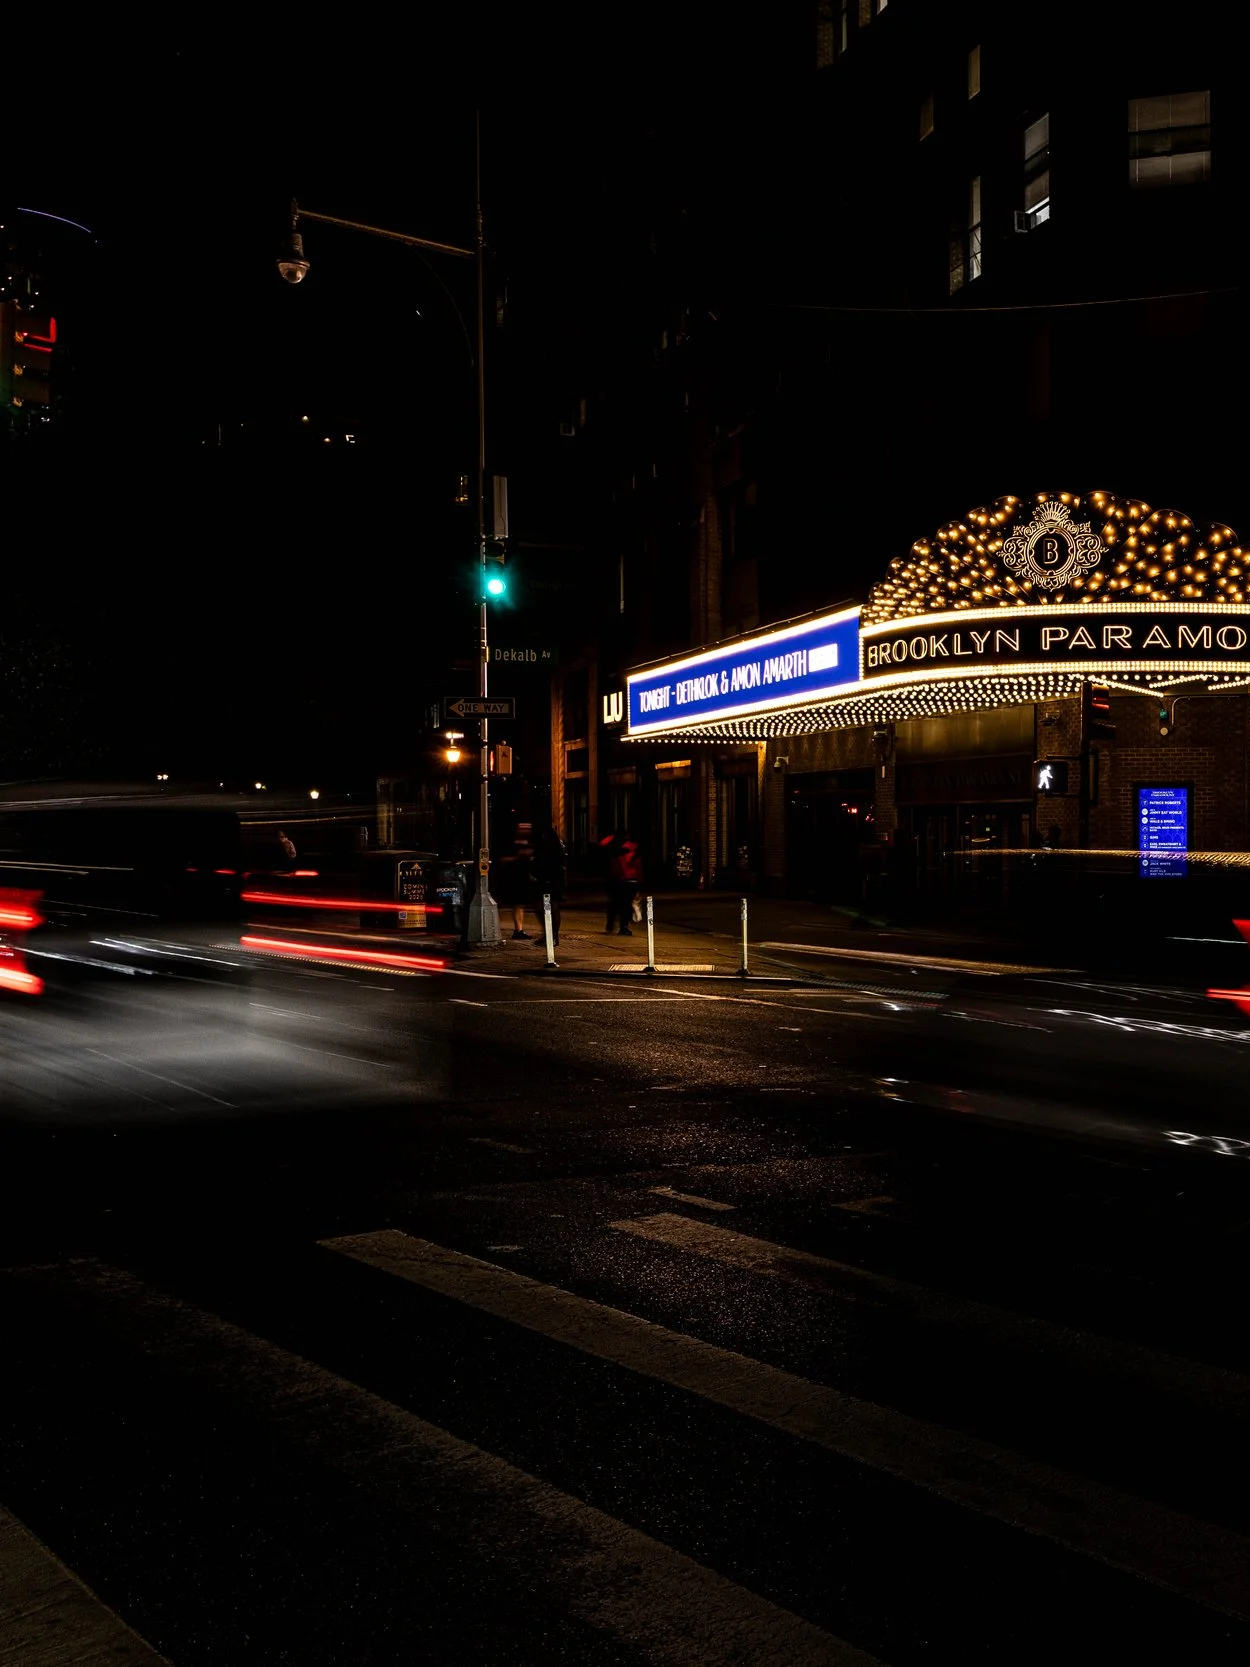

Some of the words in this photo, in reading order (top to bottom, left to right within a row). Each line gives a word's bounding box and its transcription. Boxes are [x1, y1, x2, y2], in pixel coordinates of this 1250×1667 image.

[1043, 538, 1059, 564] B
[494, 647, 537, 663] Dekalb
[868, 628, 1020, 668] BROOKLYN
[639, 685, 671, 713] TONIGHT
[676, 673, 719, 705] DETHKLOK
[721, 671, 730, 695] &
[731, 662, 761, 692] AMON
[763, 650, 807, 686] AMARTH
[457, 703, 479, 713] ONE
[483, 703, 505, 713] WAY
[603, 692, 623, 724] LIU
